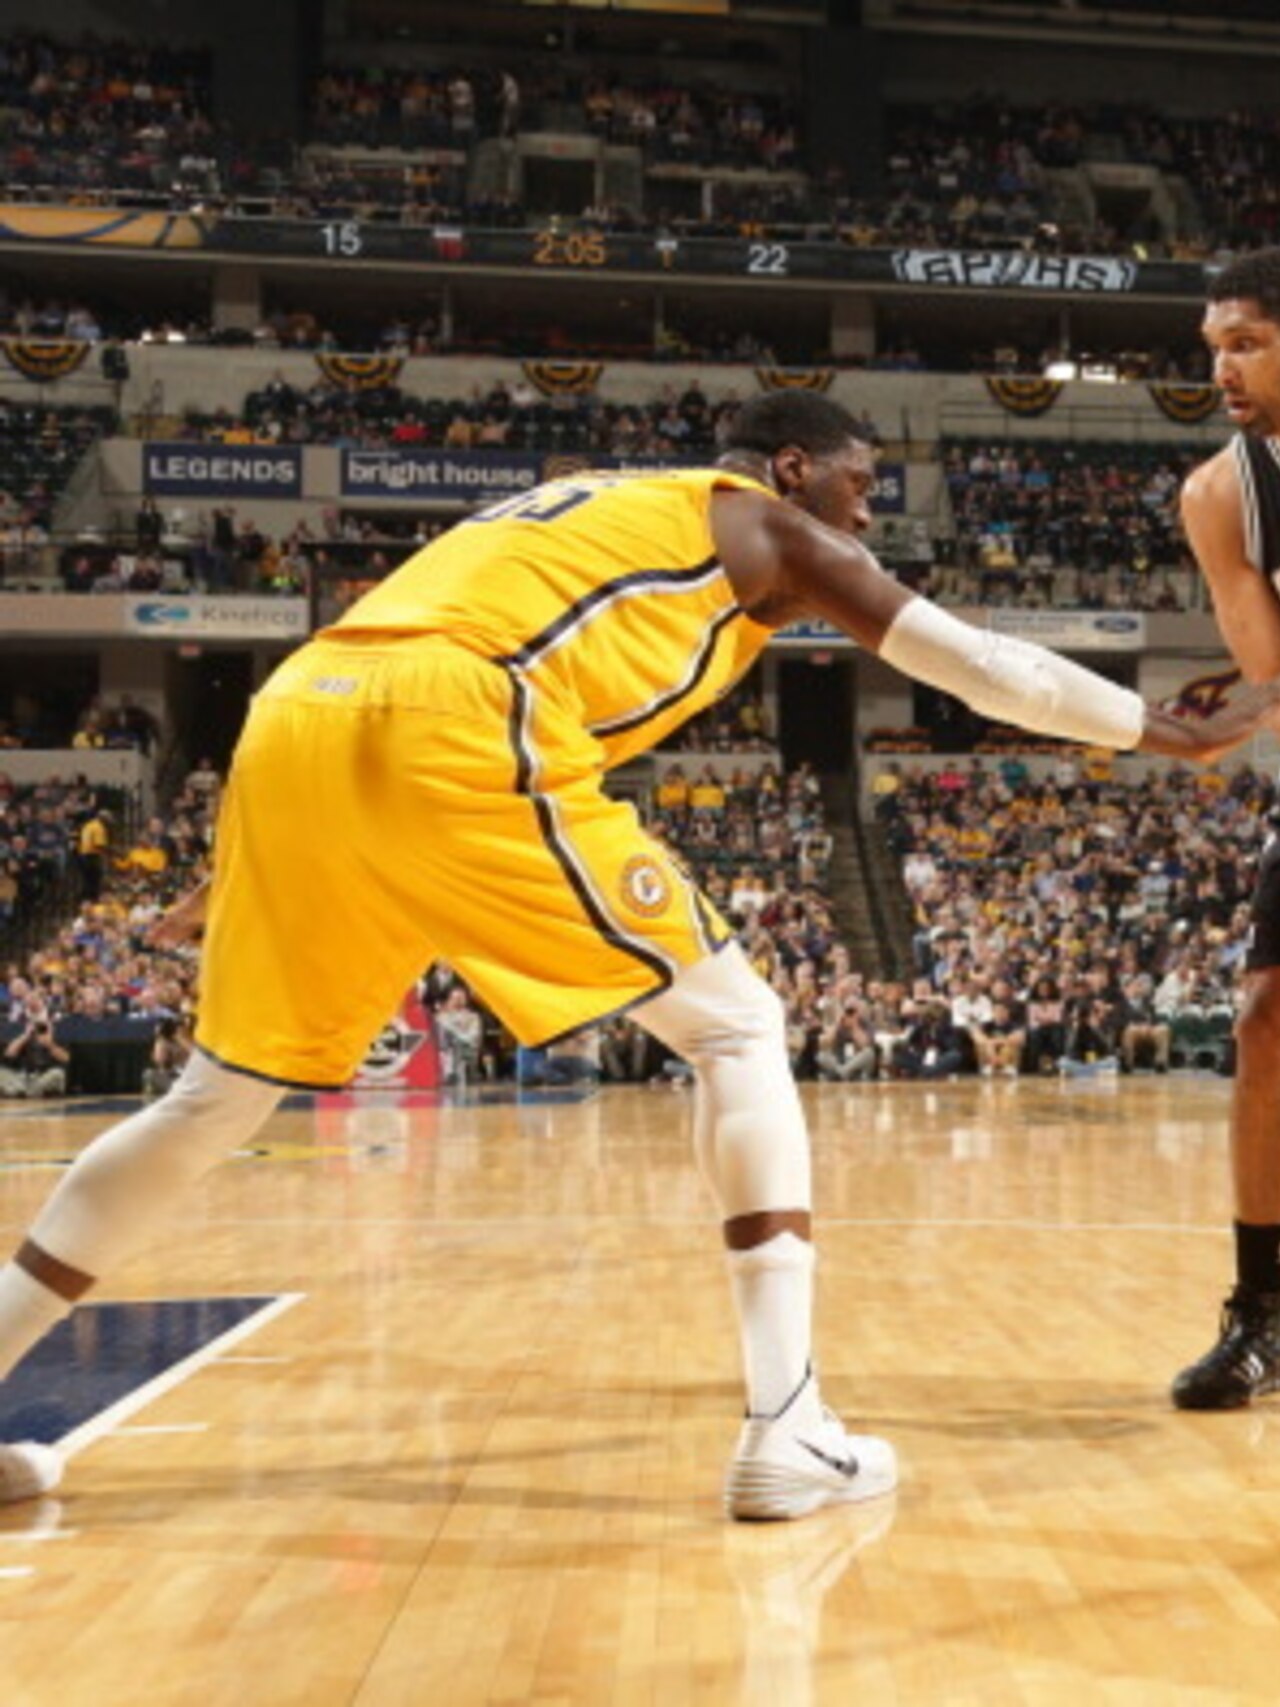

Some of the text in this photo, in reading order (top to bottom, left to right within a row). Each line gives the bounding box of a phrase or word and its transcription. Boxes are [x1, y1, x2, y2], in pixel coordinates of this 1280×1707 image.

[322, 222, 362, 255] 15
[532, 232, 605, 264] 2:05
[748, 244, 788, 273] 22
[149, 456, 295, 484] LEGENDS
[348, 457, 536, 488] bright house
